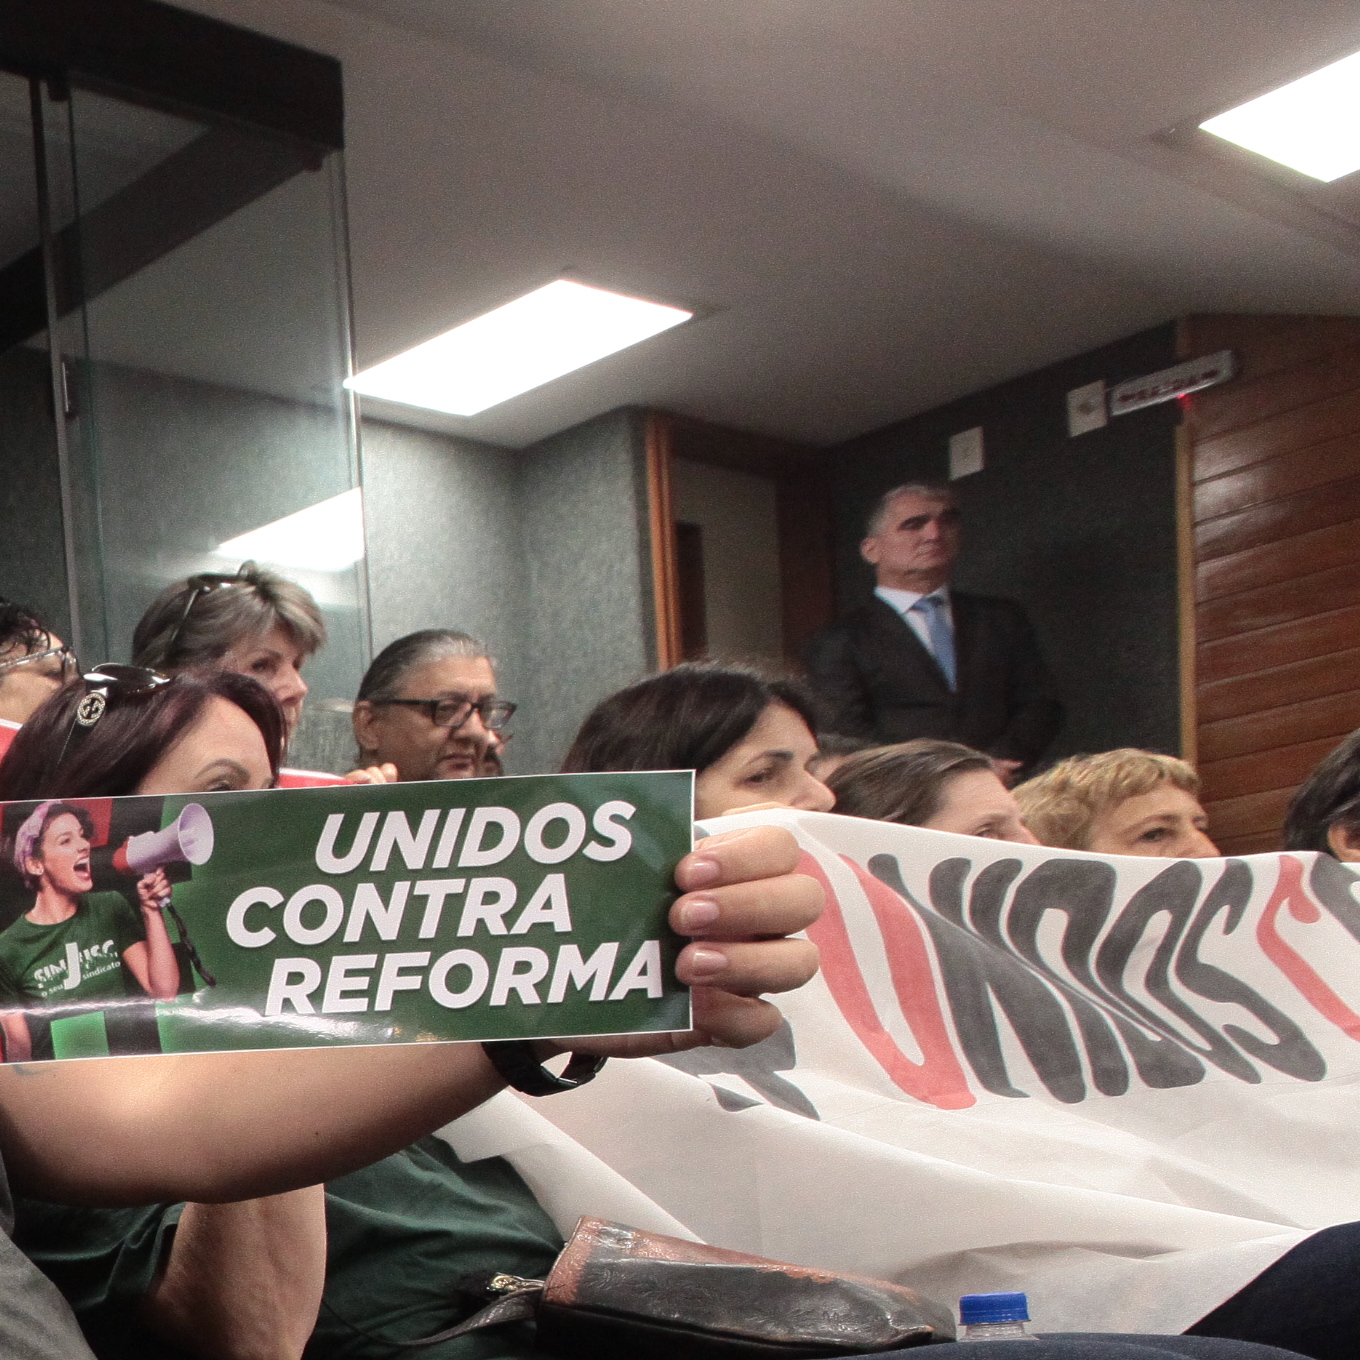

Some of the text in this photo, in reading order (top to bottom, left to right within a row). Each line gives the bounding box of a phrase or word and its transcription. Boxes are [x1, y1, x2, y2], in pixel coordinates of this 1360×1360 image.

[315, 800, 632, 874] UNIDOS
[226, 873, 572, 948] CONTRA
[264, 940, 663, 1016] REFORMA
